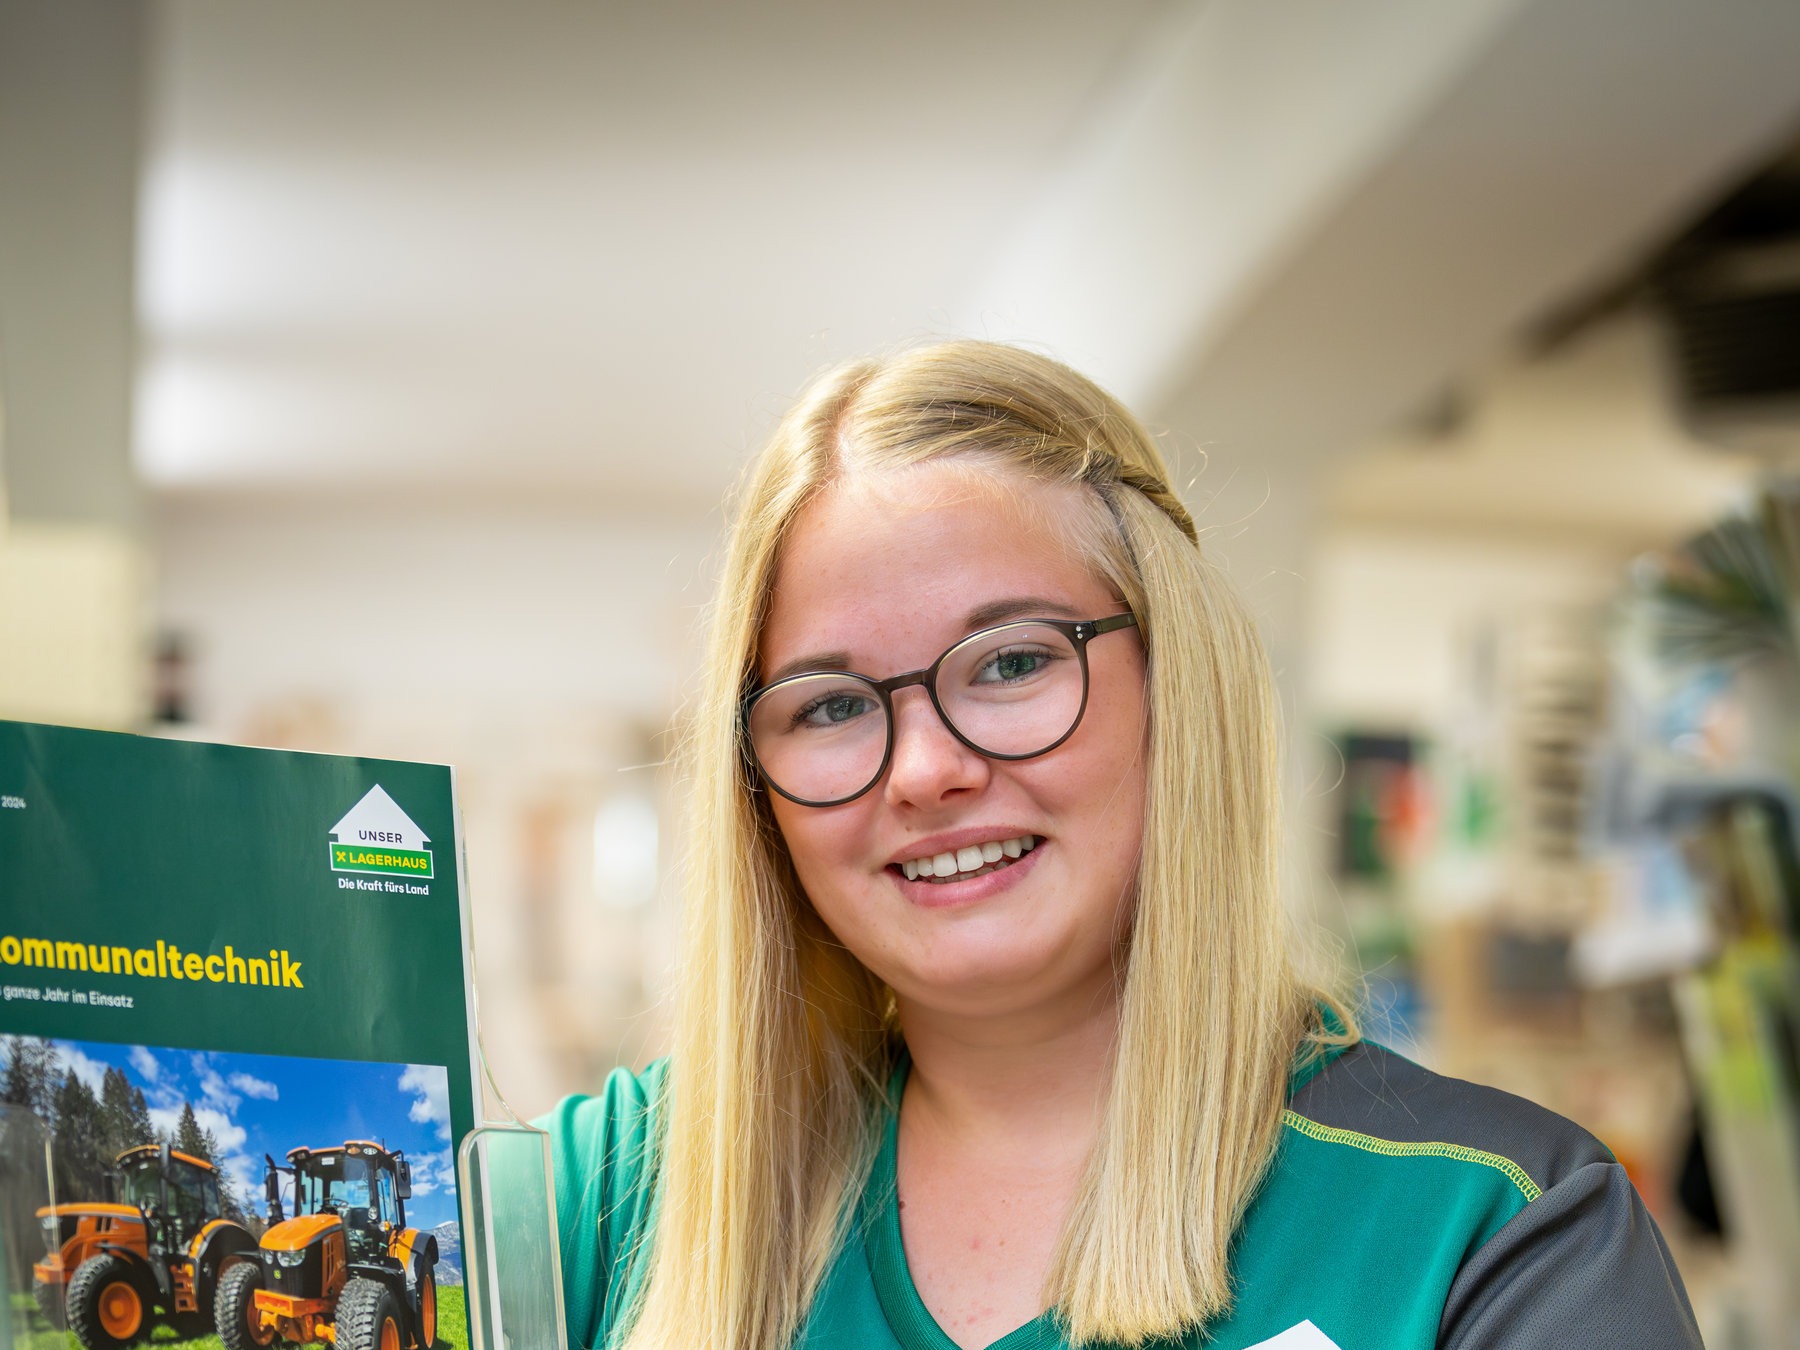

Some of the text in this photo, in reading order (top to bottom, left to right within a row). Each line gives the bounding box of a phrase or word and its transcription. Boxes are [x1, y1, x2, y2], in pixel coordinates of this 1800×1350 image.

[1, 795, 27, 809] 2024
[358, 830, 403, 843] UNSER
[349, 852, 427, 869] LAGERHAUS
[338, 878, 430, 896] Die Kraft fürs Land
[0, 935, 304, 989] ommunaltechnik
[3, 985, 41, 1001] ganze
[41, 987, 70, 1003] Jahr
[71, 989, 88, 1004] im
[88, 991, 134, 1009] Einsatz
